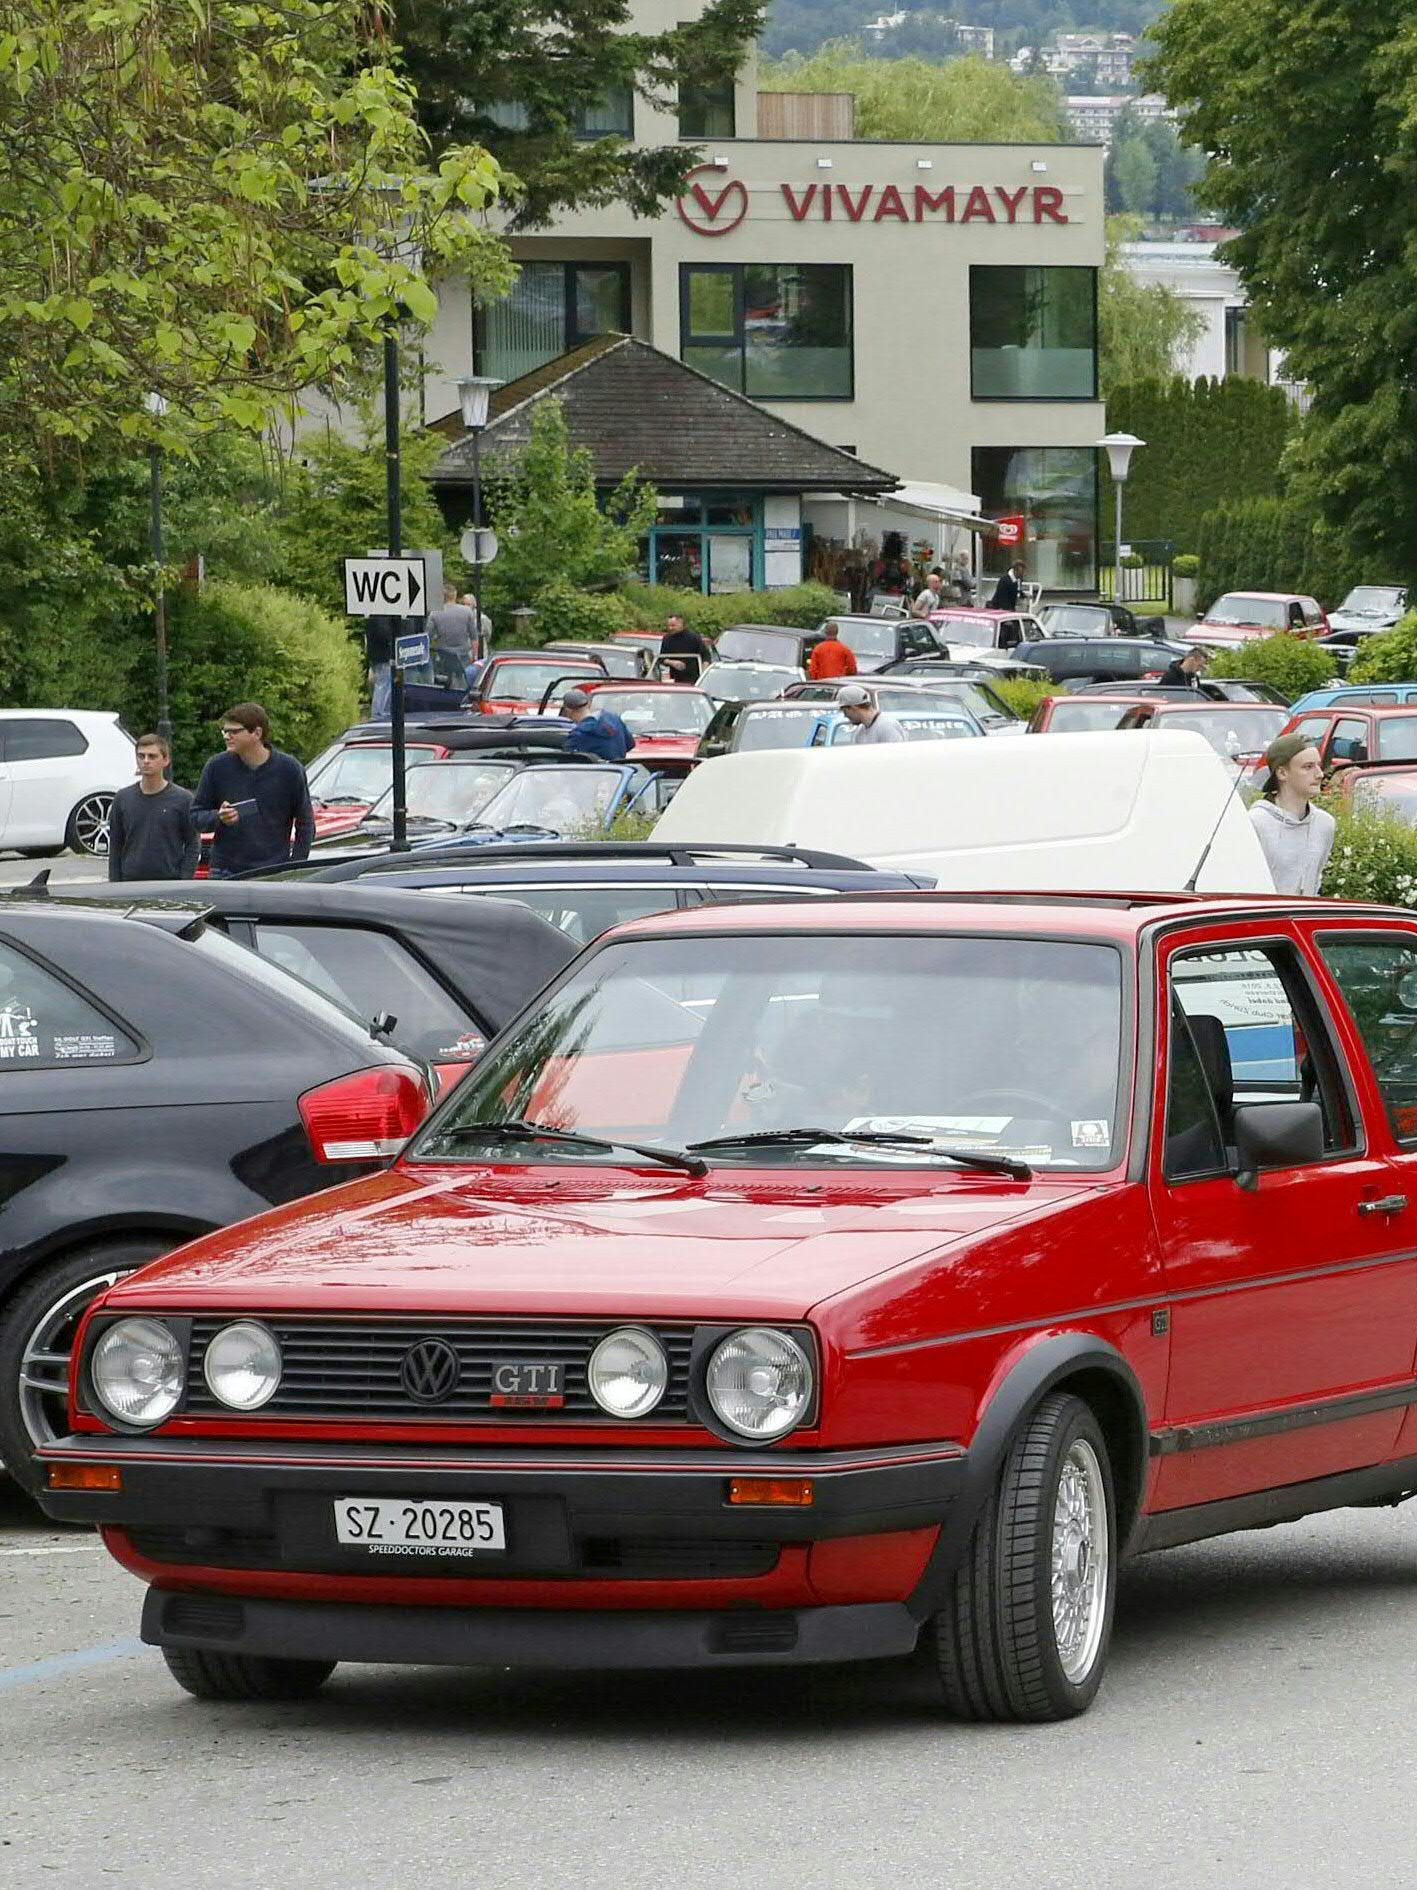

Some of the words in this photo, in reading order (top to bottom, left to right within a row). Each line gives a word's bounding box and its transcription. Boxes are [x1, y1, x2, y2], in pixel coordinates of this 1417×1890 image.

[780, 183, 1070, 225] VIVAMAYR
[352, 570, 402, 604] WC
[0, 1045, 15, 1058] MY
[18, 1044, 40, 1057] CAR
[495, 1365, 559, 1393] GTI
[346, 1506, 383, 1538] SZ
[402, 1507, 494, 1541] 20285
[368, 1544, 437, 1556] SPEEDDOCTORS
[438, 1546, 474, 1557] GARAGE
